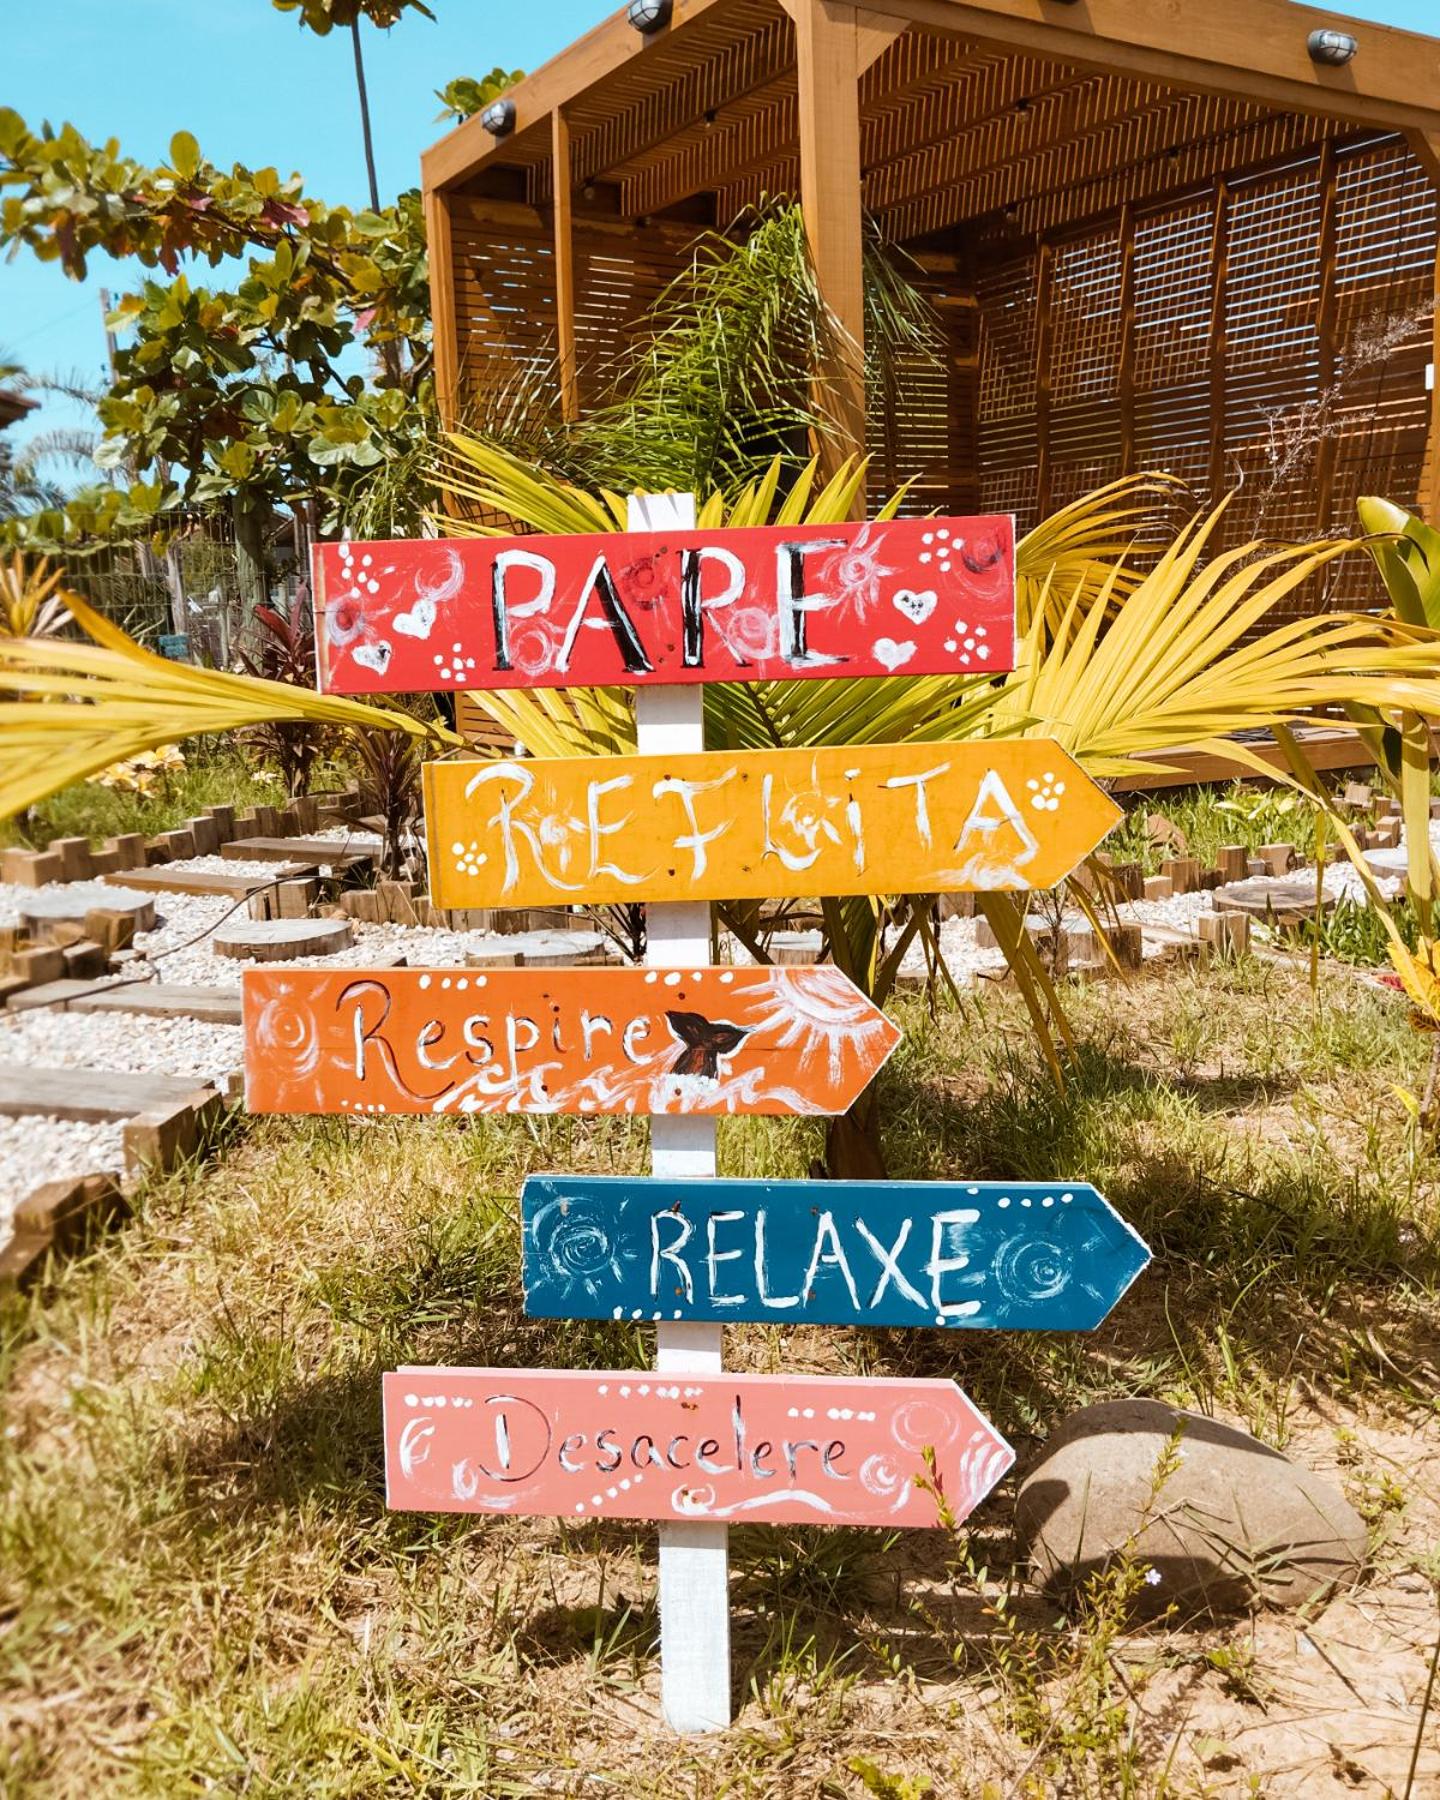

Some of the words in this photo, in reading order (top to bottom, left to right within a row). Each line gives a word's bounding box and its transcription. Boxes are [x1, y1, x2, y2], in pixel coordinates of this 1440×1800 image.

[490, 538, 850, 674] PARE
[335, 979, 654, 1099] Respire
[650, 1208, 982, 1316] RELAXE
[476, 1394, 852, 1482] Desacelere
